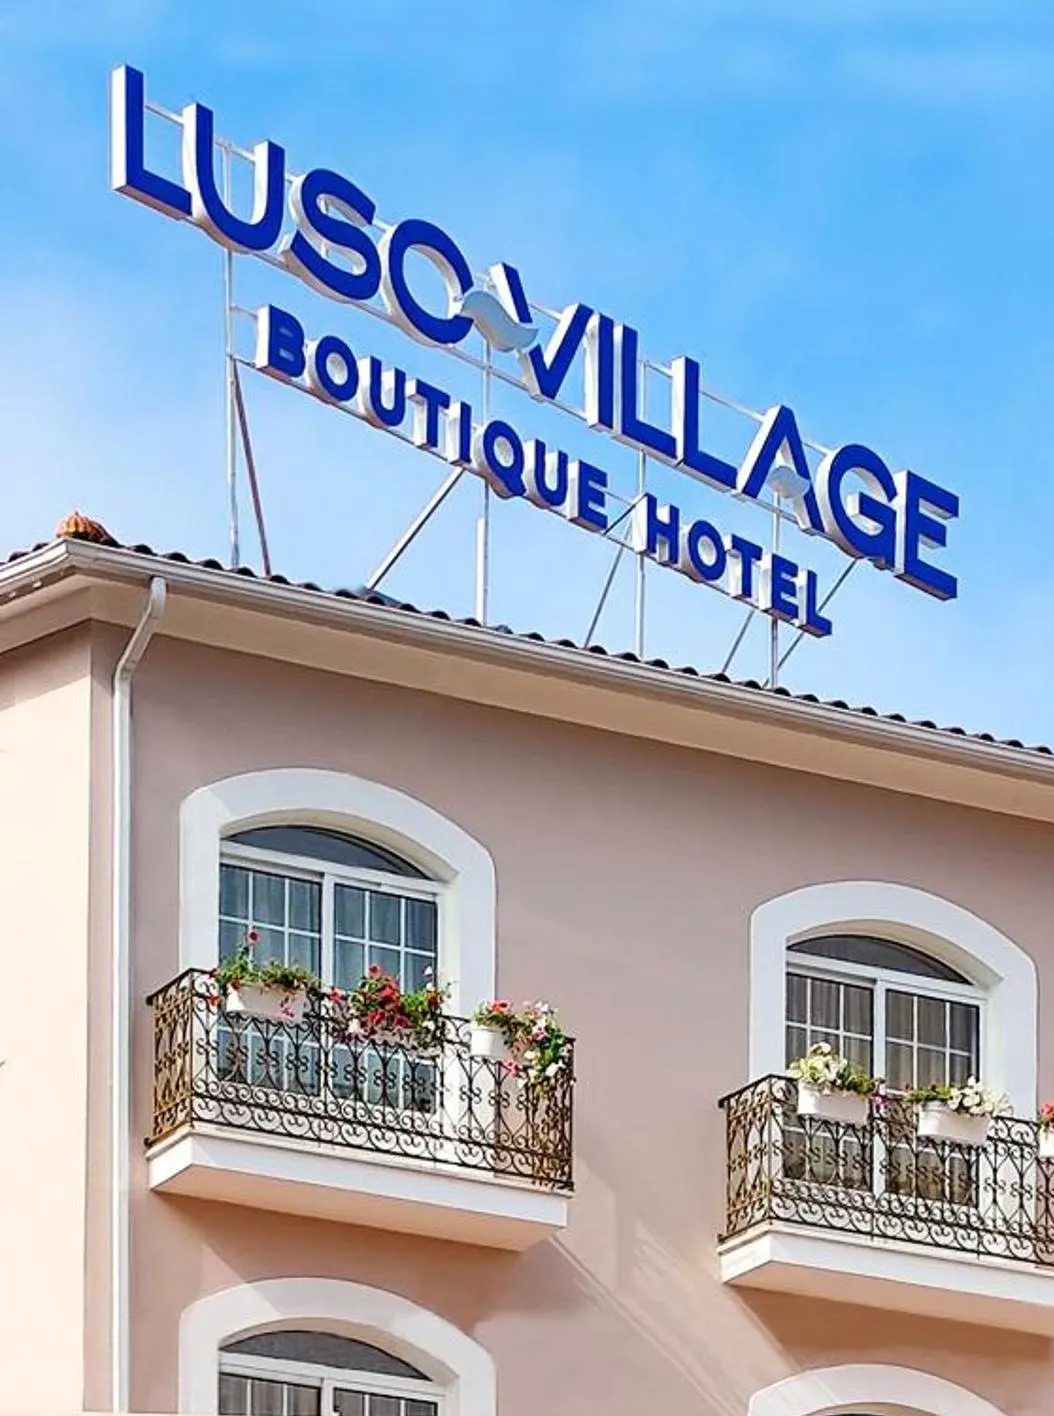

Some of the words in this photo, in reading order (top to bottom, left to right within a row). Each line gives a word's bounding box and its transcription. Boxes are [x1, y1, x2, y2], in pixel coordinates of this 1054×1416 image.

[110, 64, 476, 346] LUSO
[486, 261, 960, 601] VILLAGE
[256, 303, 609, 535] BOUTIQUE
[634, 493, 833, 639] HOTEL
